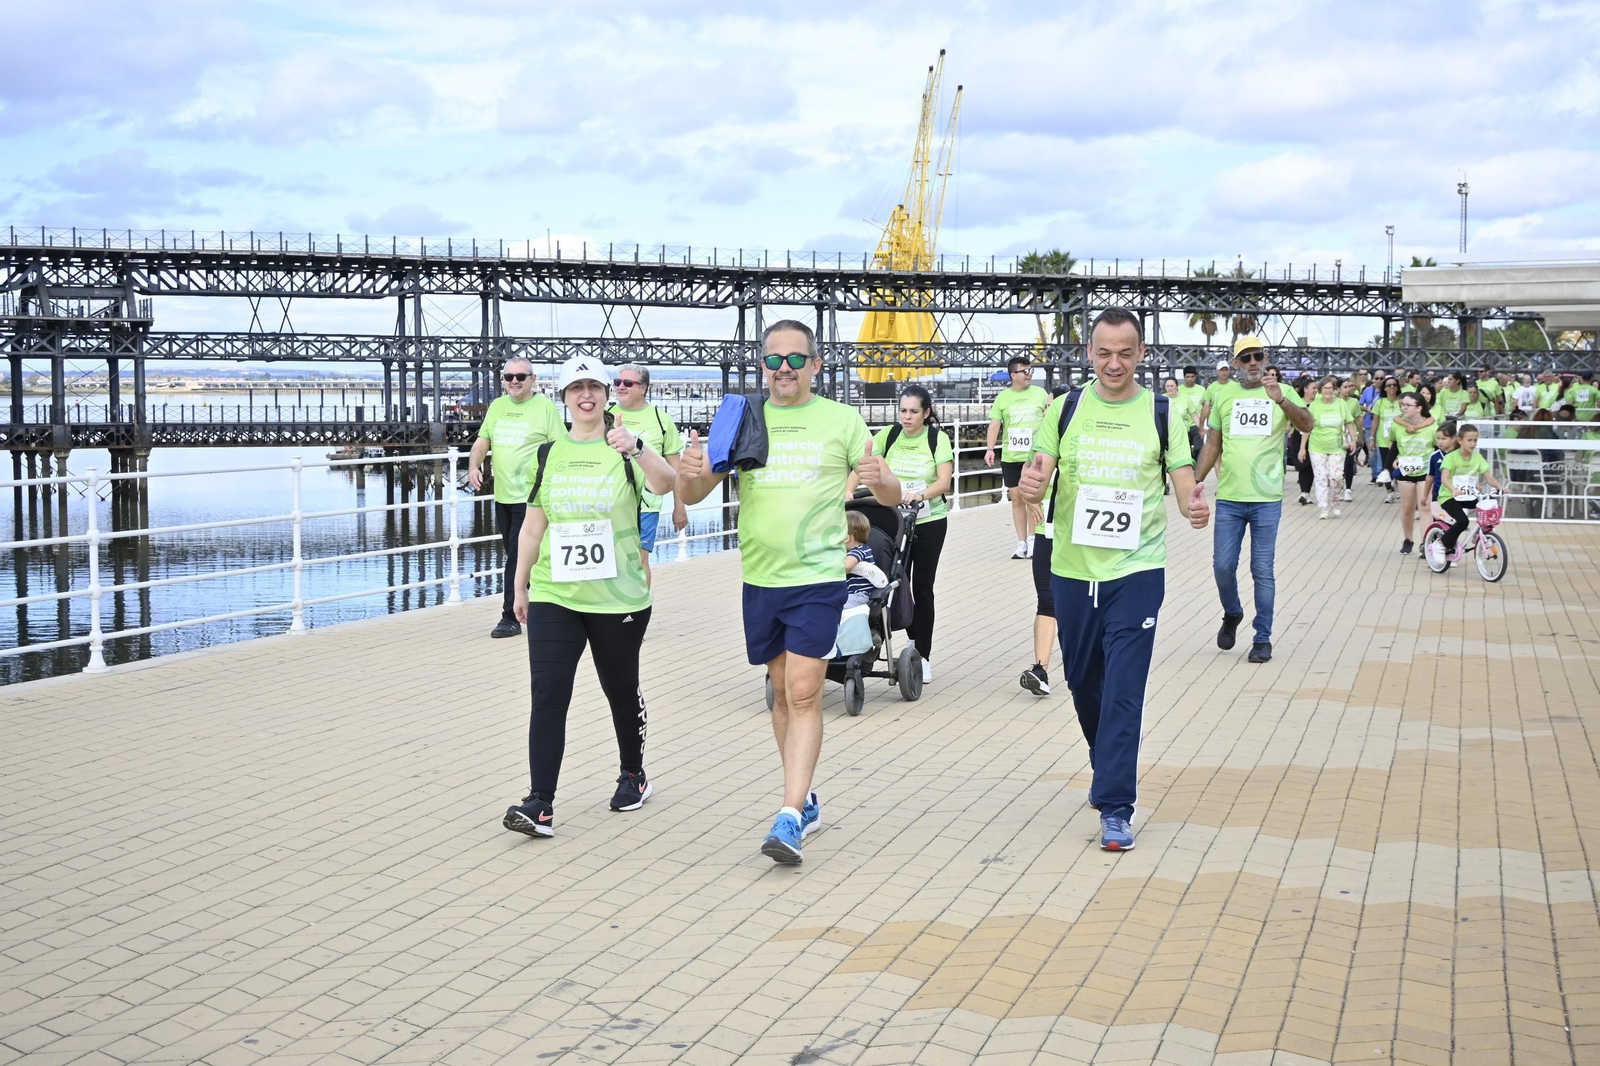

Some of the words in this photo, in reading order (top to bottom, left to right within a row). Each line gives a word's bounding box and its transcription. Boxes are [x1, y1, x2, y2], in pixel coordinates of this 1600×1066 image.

[773, 440, 824, 451] marcha
[1080, 434, 1094, 445] En
[1098, 438, 1145, 451] marcha
[806, 453, 822, 466] el
[1068, 435, 1079, 483] HUELVA
[1077, 450, 1125, 463] contra
[1127, 454, 1143, 466] el
[551, 474, 566, 483] En
[569, 474, 614, 483] marcha
[755, 466, 821, 483] cáncer
[1078, 461, 1140, 482] cáncer
[550, 486, 596, 497] contra
[600, 486, 613, 497] el
[552, 497, 614, 513] cáncer
[1085, 508, 1131, 533] 729
[561, 543, 605, 566] 730
